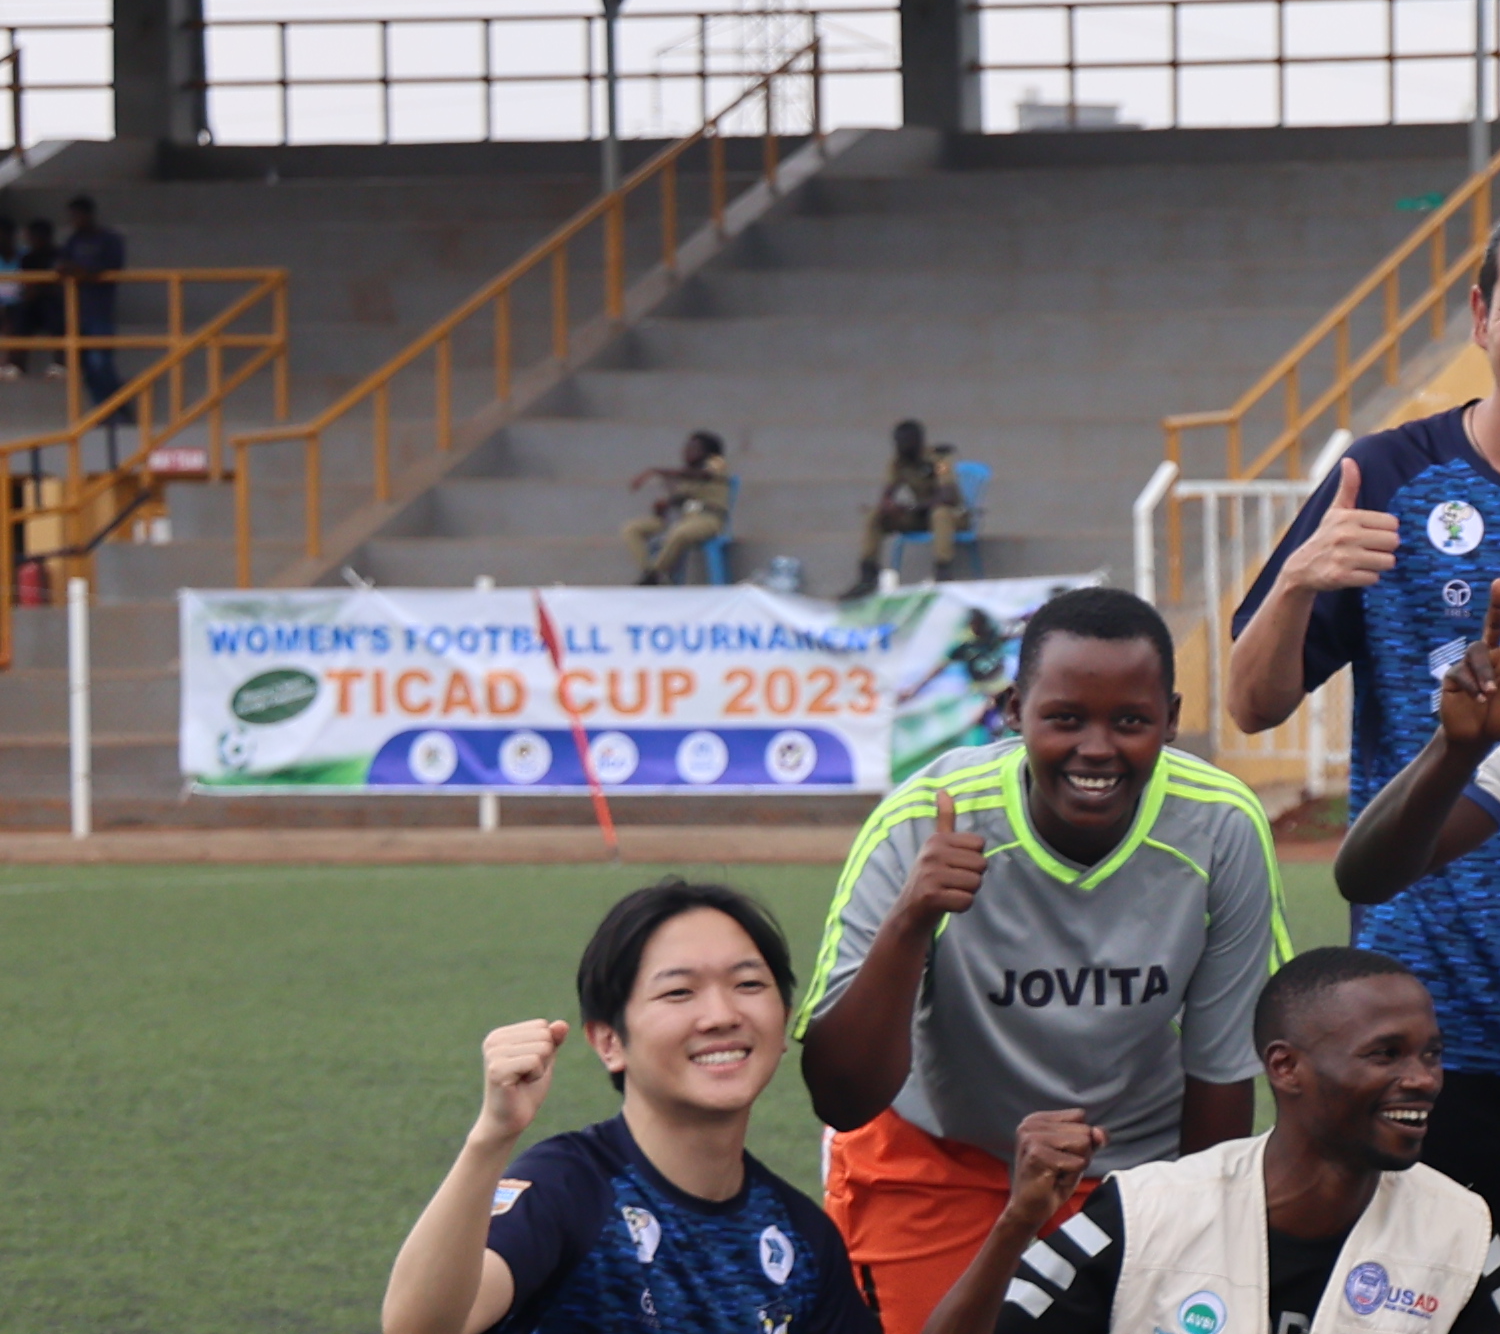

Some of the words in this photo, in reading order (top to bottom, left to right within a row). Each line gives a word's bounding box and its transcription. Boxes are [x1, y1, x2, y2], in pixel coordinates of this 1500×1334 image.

[205, 623, 393, 655] WOMEN'S
[325, 668, 528, 715] TICAD
[556, 668, 698, 715] CUP
[721, 667, 881, 715] 2023
[988, 964, 1170, 1008] JOVITA
